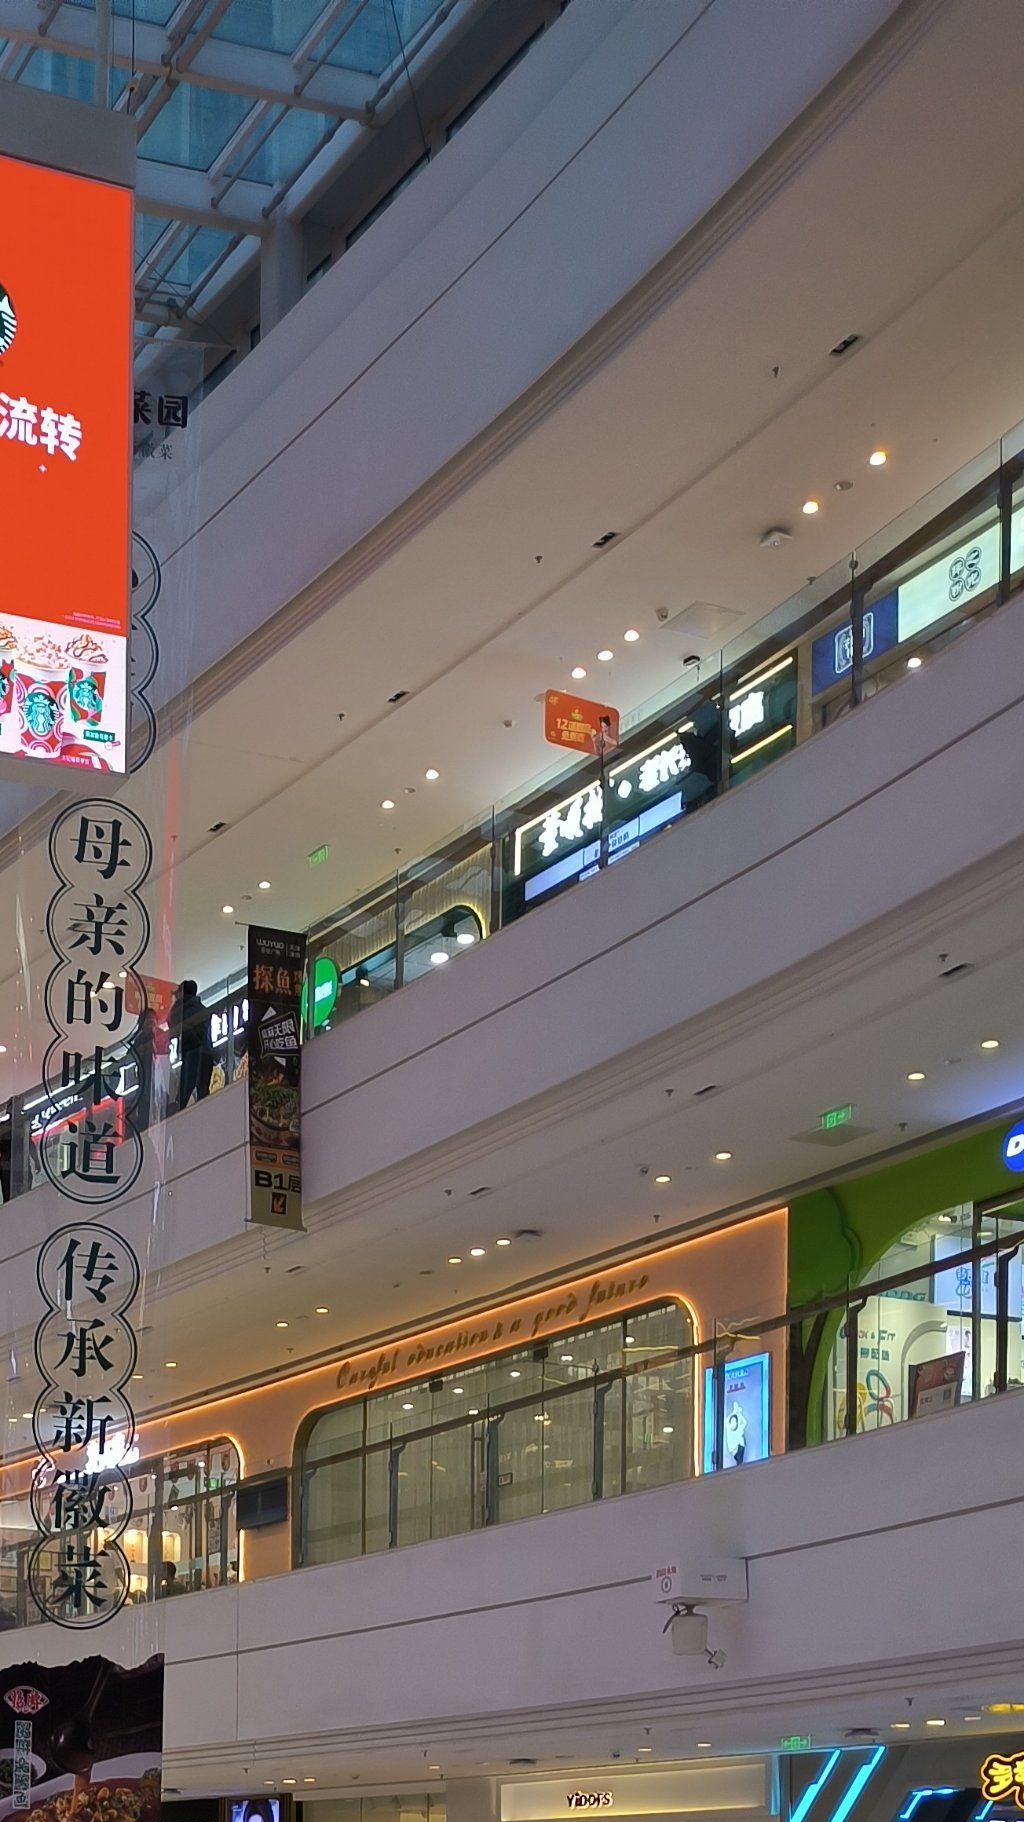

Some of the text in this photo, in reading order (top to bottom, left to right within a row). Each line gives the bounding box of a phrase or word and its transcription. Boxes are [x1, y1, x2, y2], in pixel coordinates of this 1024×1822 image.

[60, 815, 132, 1185] 母亲的味道
[51, 1237, 120, 1609] 传承新徽菜
[336, 1348, 399, 1390] Careful
[407, 1329, 488, 1366] education
[531, 1292, 577, 1337] good
[578, 1274, 650, 1323] future
